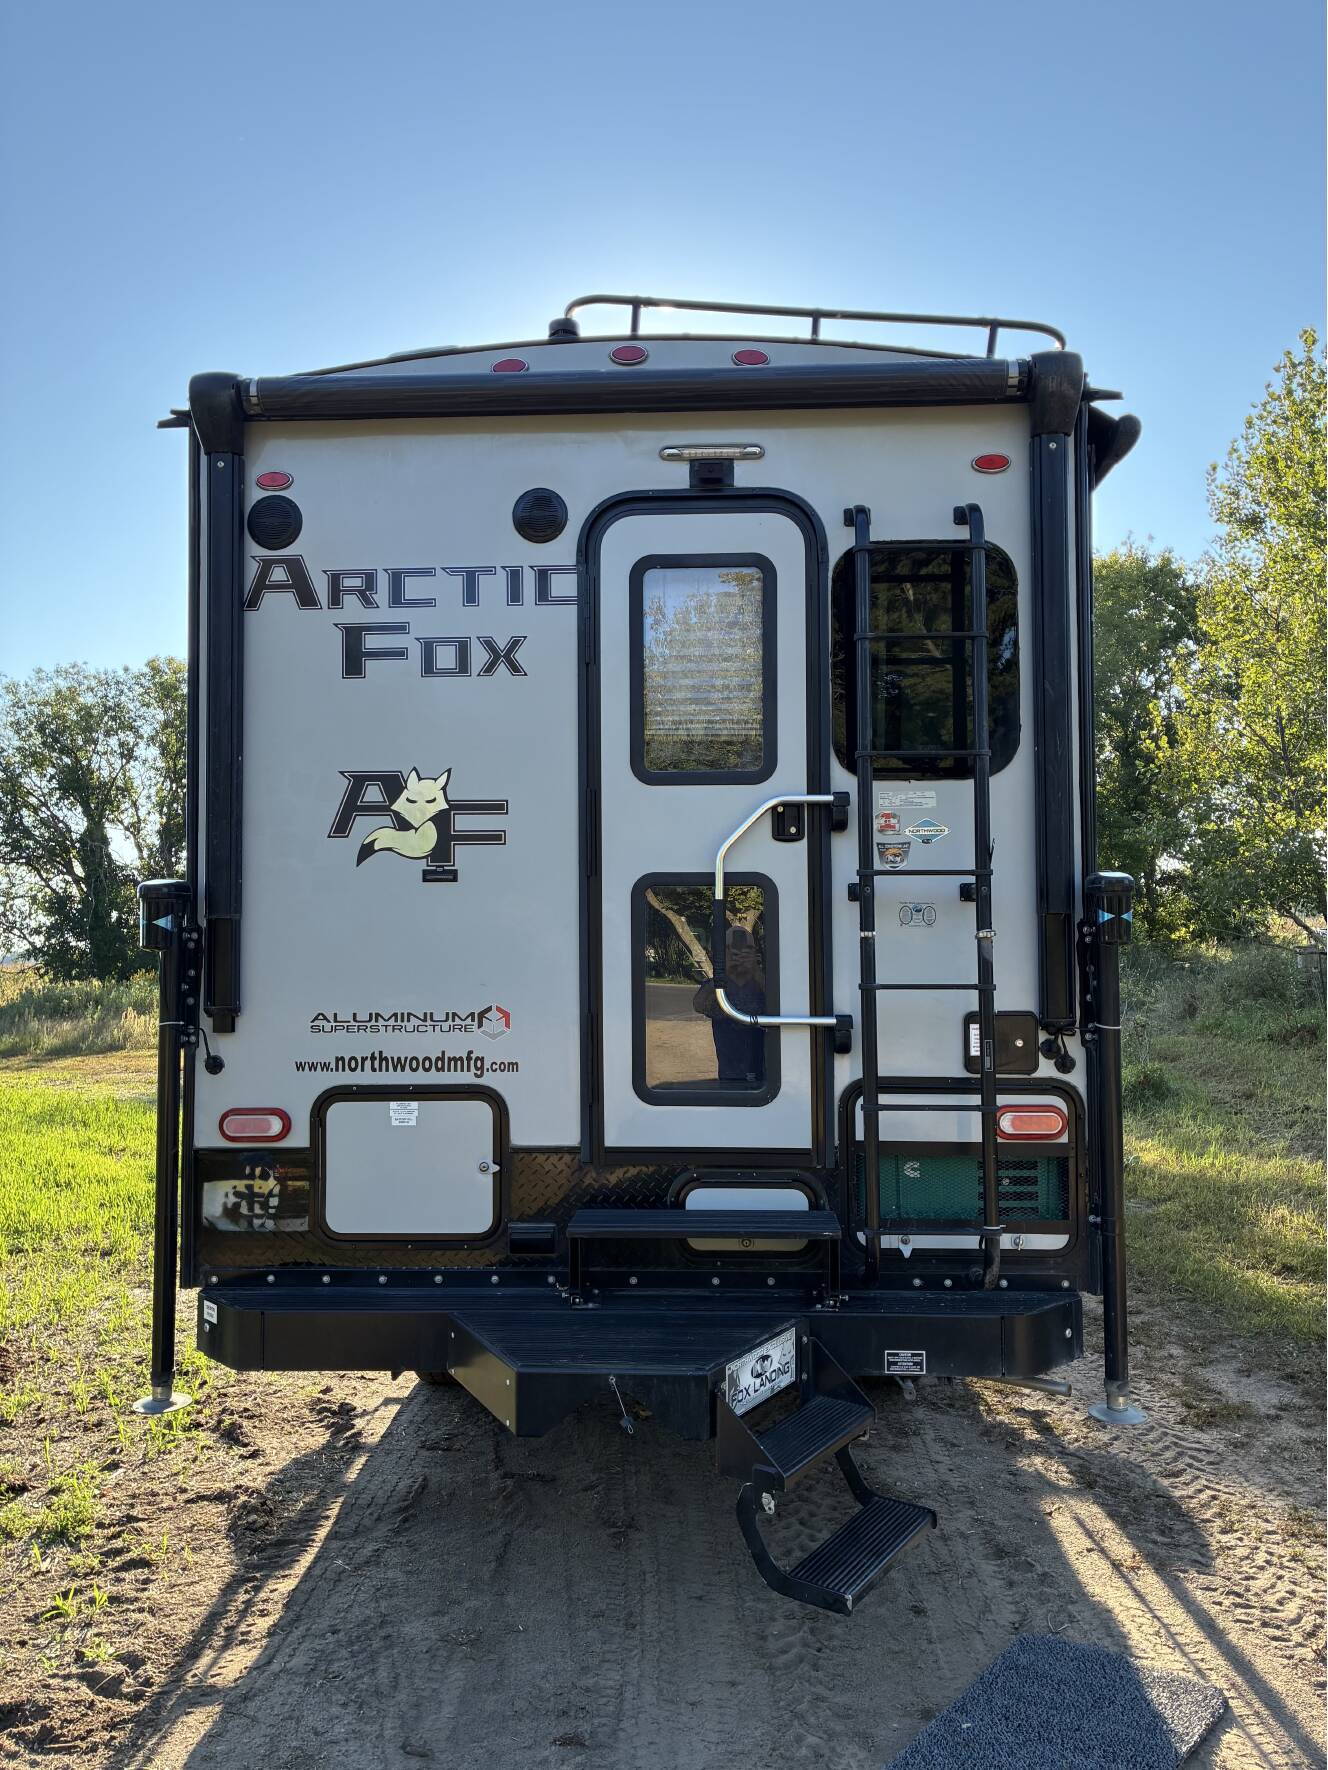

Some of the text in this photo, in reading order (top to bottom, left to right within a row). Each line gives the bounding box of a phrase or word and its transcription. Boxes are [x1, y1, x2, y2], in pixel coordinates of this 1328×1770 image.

[243, 554, 577, 611] ARCTIC
[332, 622, 528, 679] FOX
[309, 1011, 476, 1023] ALUMINUM
[309, 1024, 475, 1034] SUPERSTRUCTURE
[294, 1050, 519, 1079] www.northwoodmfg.com
[731, 1361, 790, 1405] FOX LANDING
